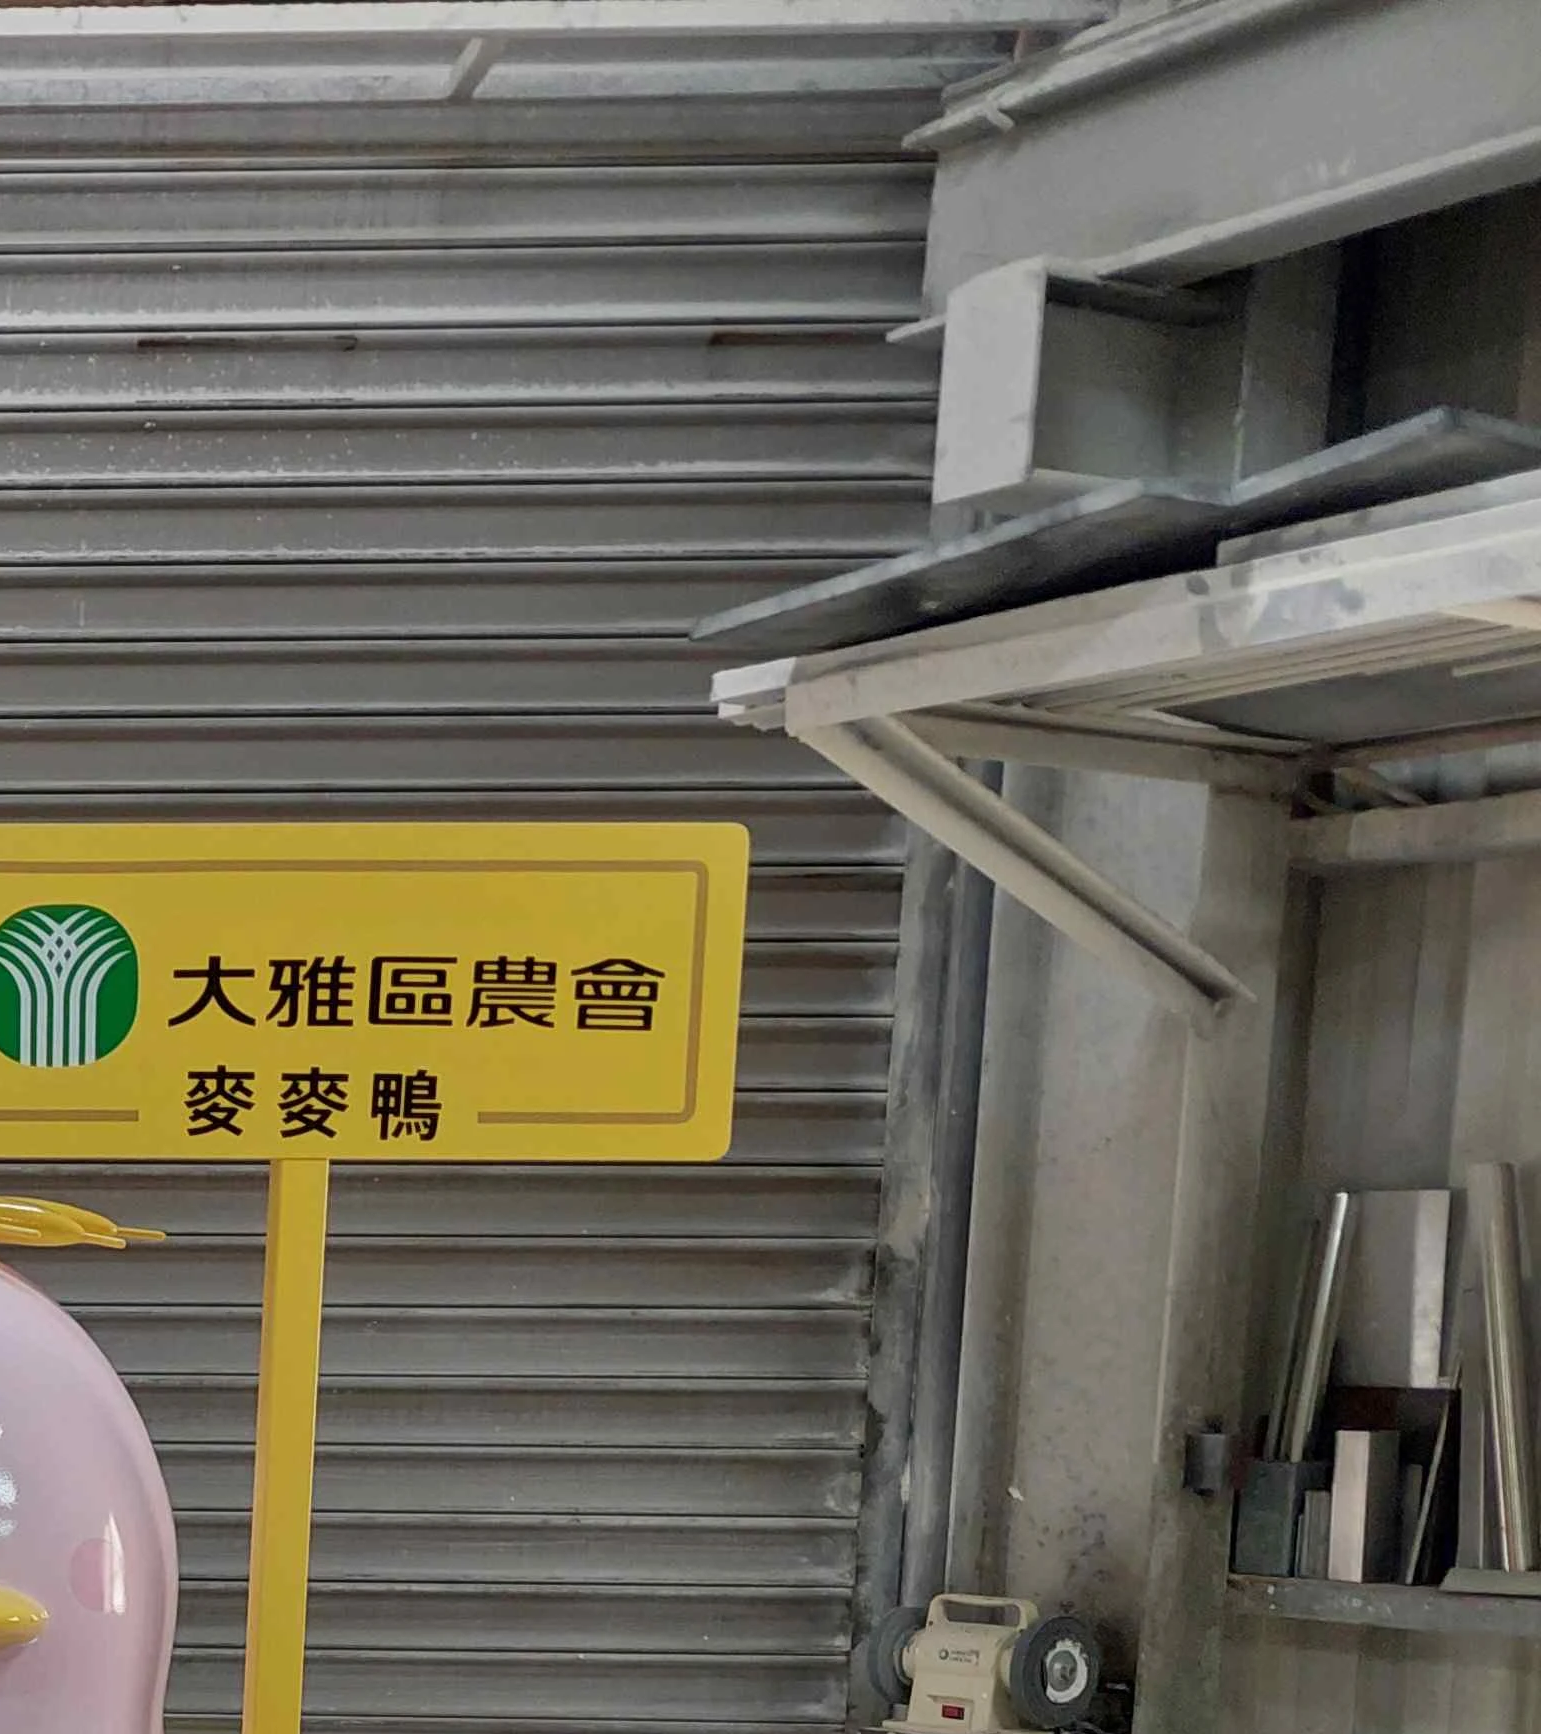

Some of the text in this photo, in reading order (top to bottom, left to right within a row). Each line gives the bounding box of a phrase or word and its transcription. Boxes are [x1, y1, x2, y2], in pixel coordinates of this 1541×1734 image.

[167, 955, 667, 1032] 大雅區農會
[185, 1065, 444, 1142] 麥麥鴨
